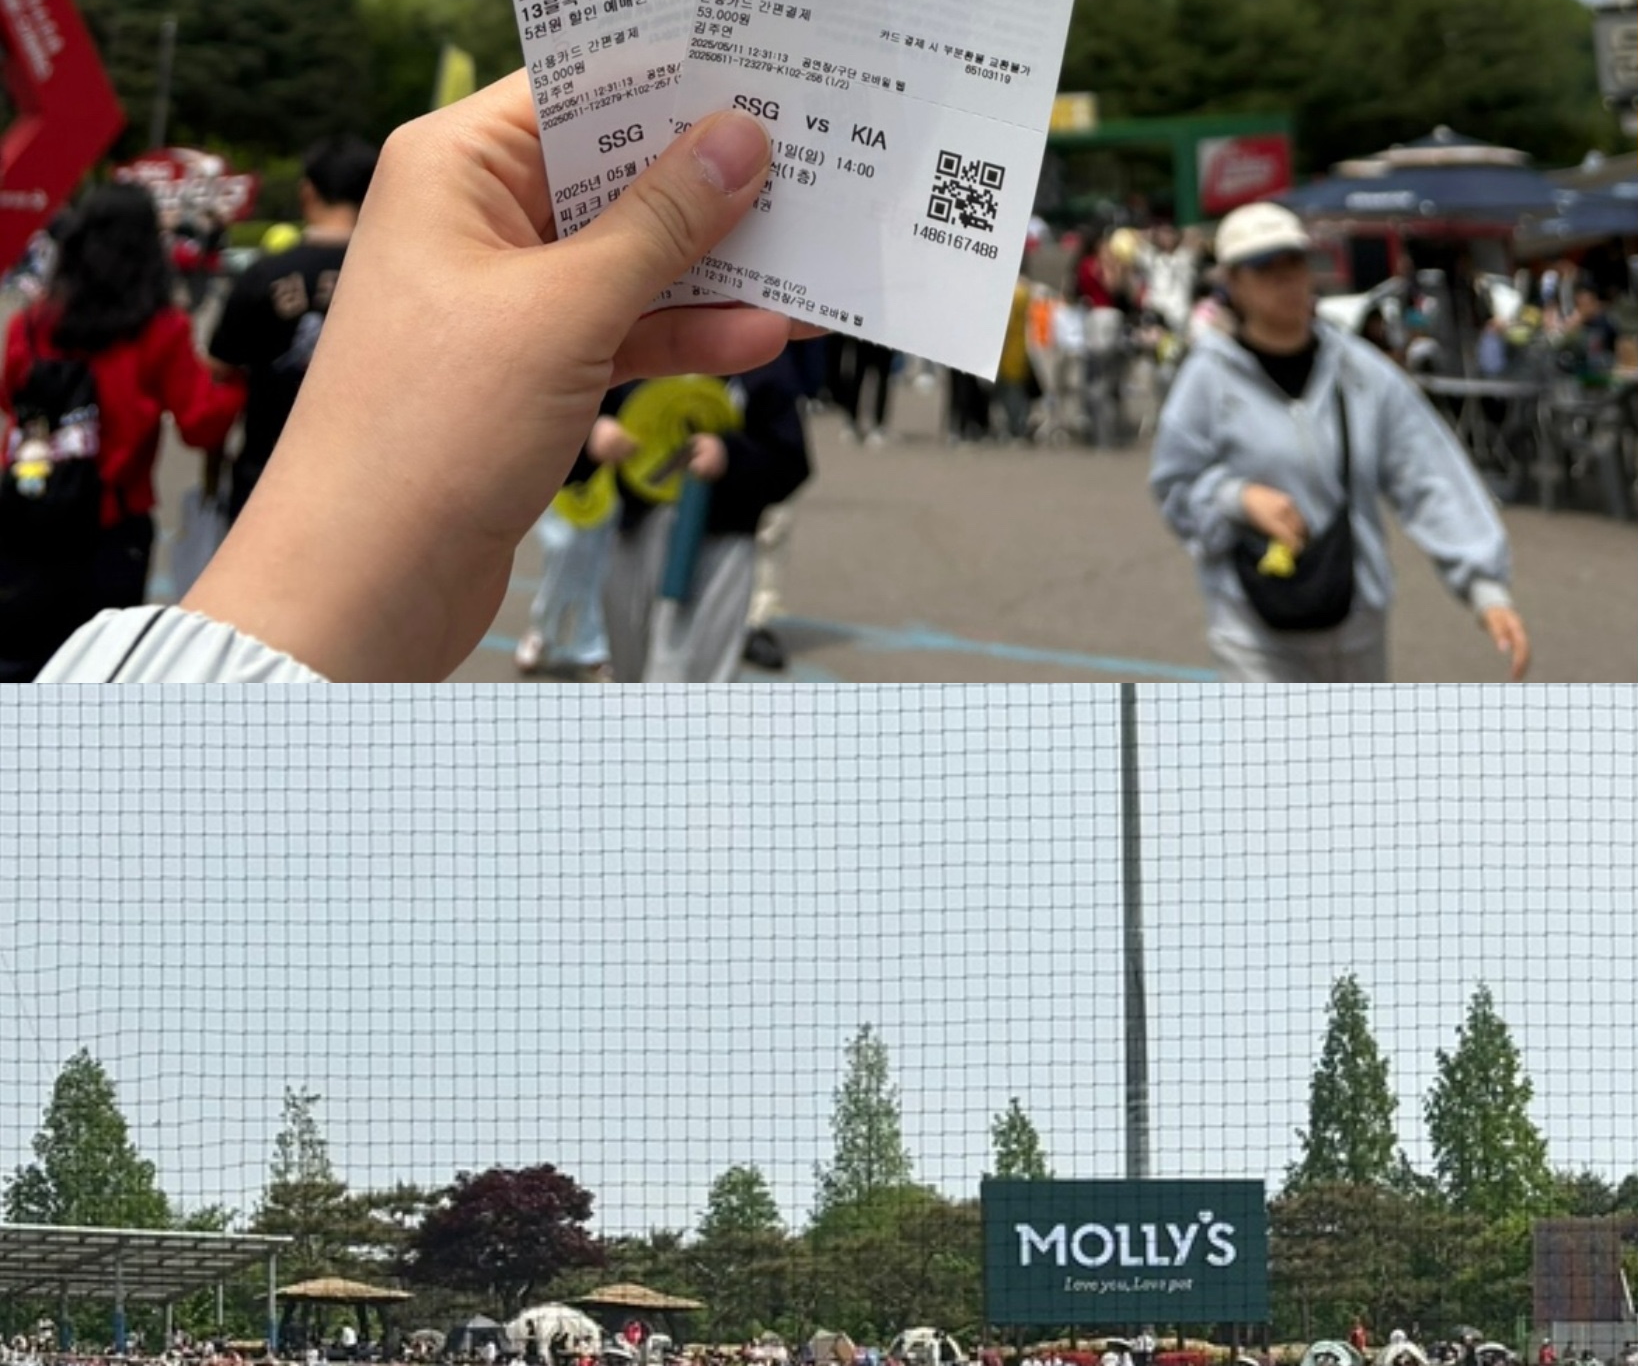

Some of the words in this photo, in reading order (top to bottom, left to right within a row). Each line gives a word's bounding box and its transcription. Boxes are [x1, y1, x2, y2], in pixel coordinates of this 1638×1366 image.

[525, 17, 562, 40] 5천원
[569, 5, 597, 25] 할인
[759, 0, 812, 22] 간편결제
[531, 47, 583, 73] 신용카드
[588, 26, 640, 53] 간편결제
[880, 29, 900, 43] 카드
[904, 35, 925, 49] 결제
[928, 42, 939, 53] 시
[691, 38, 743, 54] 2025/05/11
[748, 46, 789, 63] 12:31:13
[861, 73, 892, 89] 모바일
[540, 91, 590, 118] 2025/05/11
[594, 77, 634, 97] 12:31:13
[825, 76, 850, 91] (1/2)
[598, 123, 644, 154] SSG
[732, 94, 781, 121] SSG
[851, 123, 887, 150] KIA
[555, 175, 601, 204] 2025년
[606, 161, 637, 182] 05월
[836, 157, 875, 178] 14:00
[560, 196, 603, 222] 피코크
[912, 223, 999, 260] 1486167488
[704, 270, 743, 289] 12:31:13
[819, 305, 850, 323] 모바일
[783, 280, 807, 296] (1/2)
[1014, 1210, 1237, 1266] MOLLY'S
[1064, 1276, 1097, 1291] Love
[1168, 1278, 1193, 1293] pet
